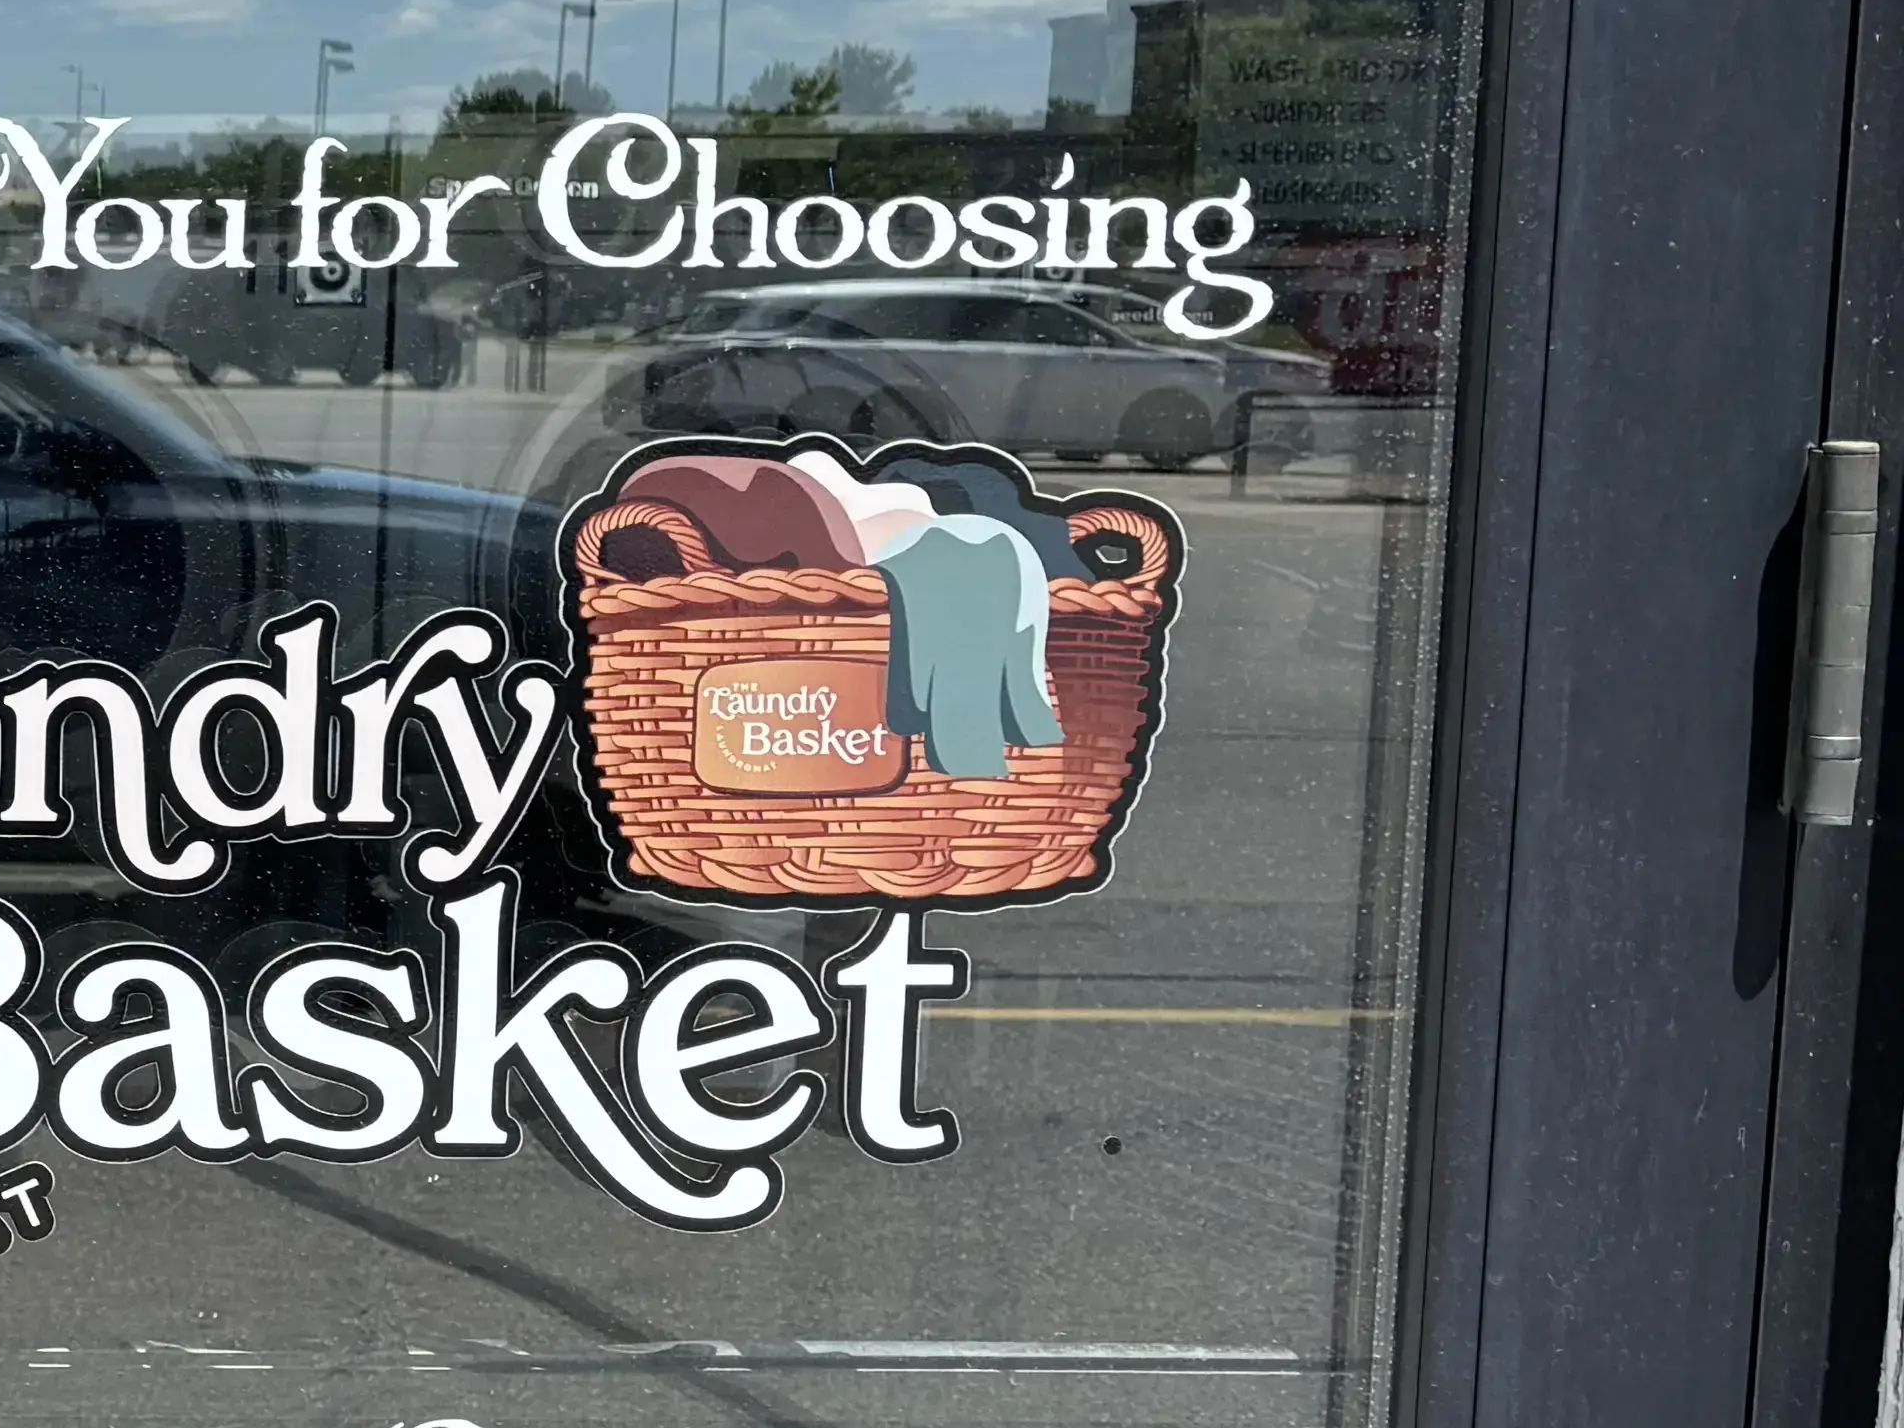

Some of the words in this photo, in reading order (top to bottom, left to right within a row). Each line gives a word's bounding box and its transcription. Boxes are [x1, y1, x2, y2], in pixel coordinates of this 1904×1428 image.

[288, 137, 510, 268] for
[538, 113, 1273, 339] Choosing
[703, 685, 837, 721] Laundry
[733, 682, 758, 692] THE
[715, 725, 778, 773] LAUNDROMAT
[742, 720, 888, 764] Basket
